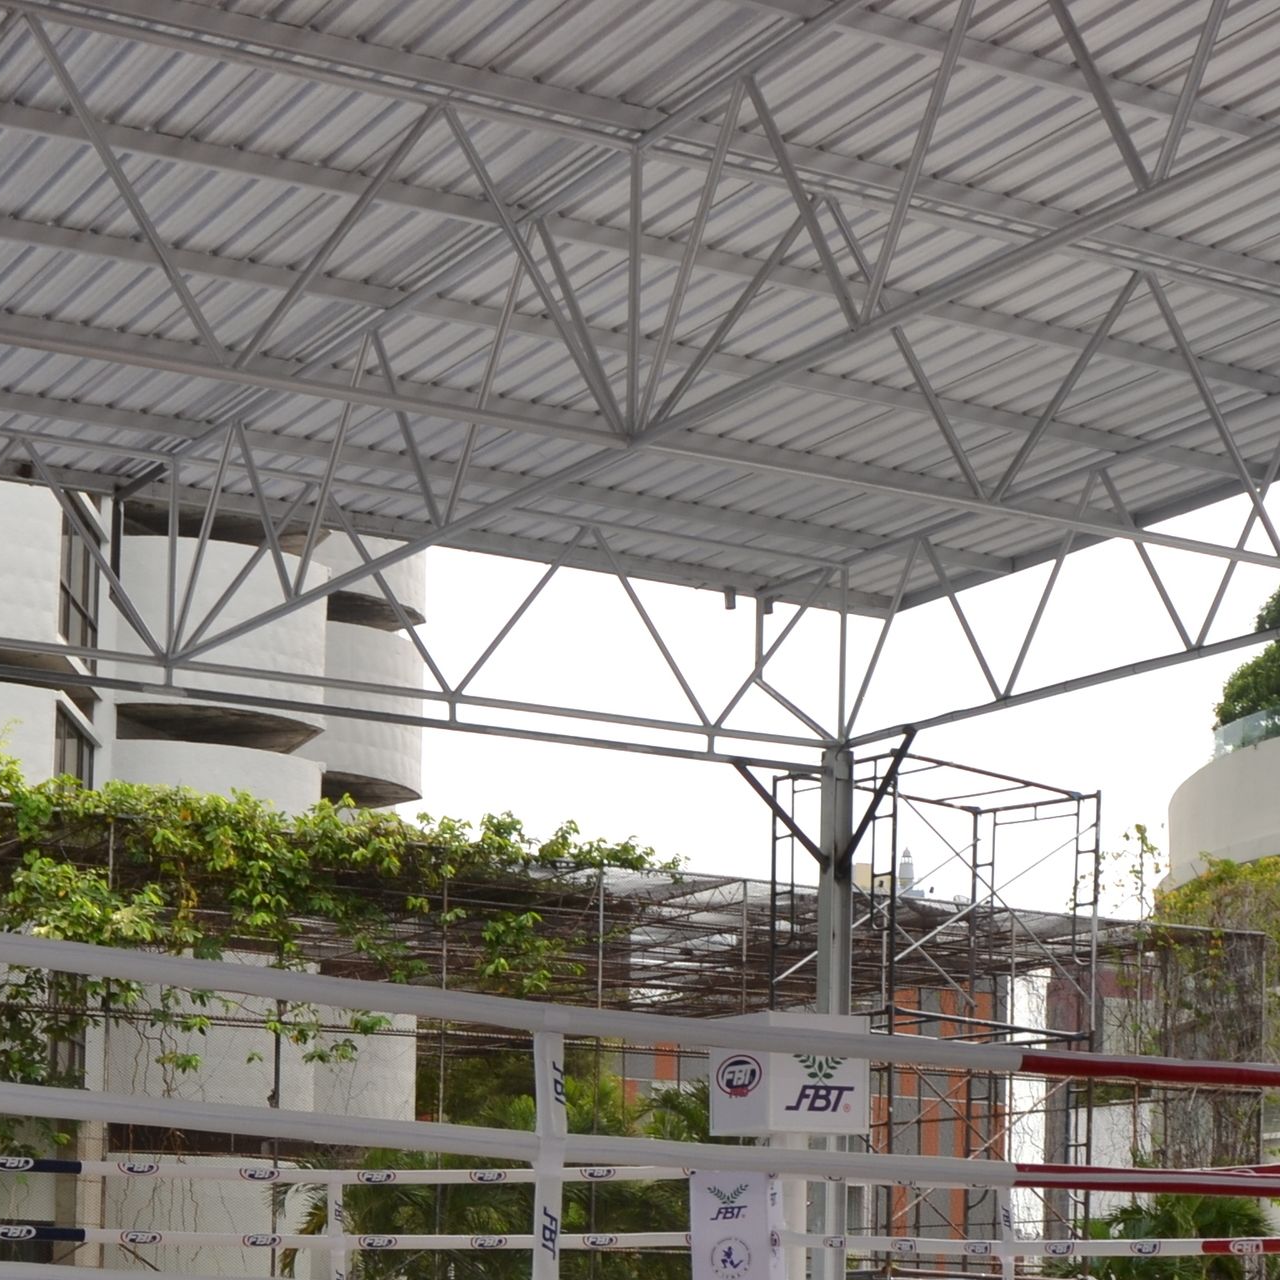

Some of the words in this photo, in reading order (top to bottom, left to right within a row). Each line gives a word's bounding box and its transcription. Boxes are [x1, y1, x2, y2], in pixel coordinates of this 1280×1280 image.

[785, 1085, 855, 1112] FBT
[709, 1205, 748, 1220] FBT
[542, 1206, 558, 1260] FBT
